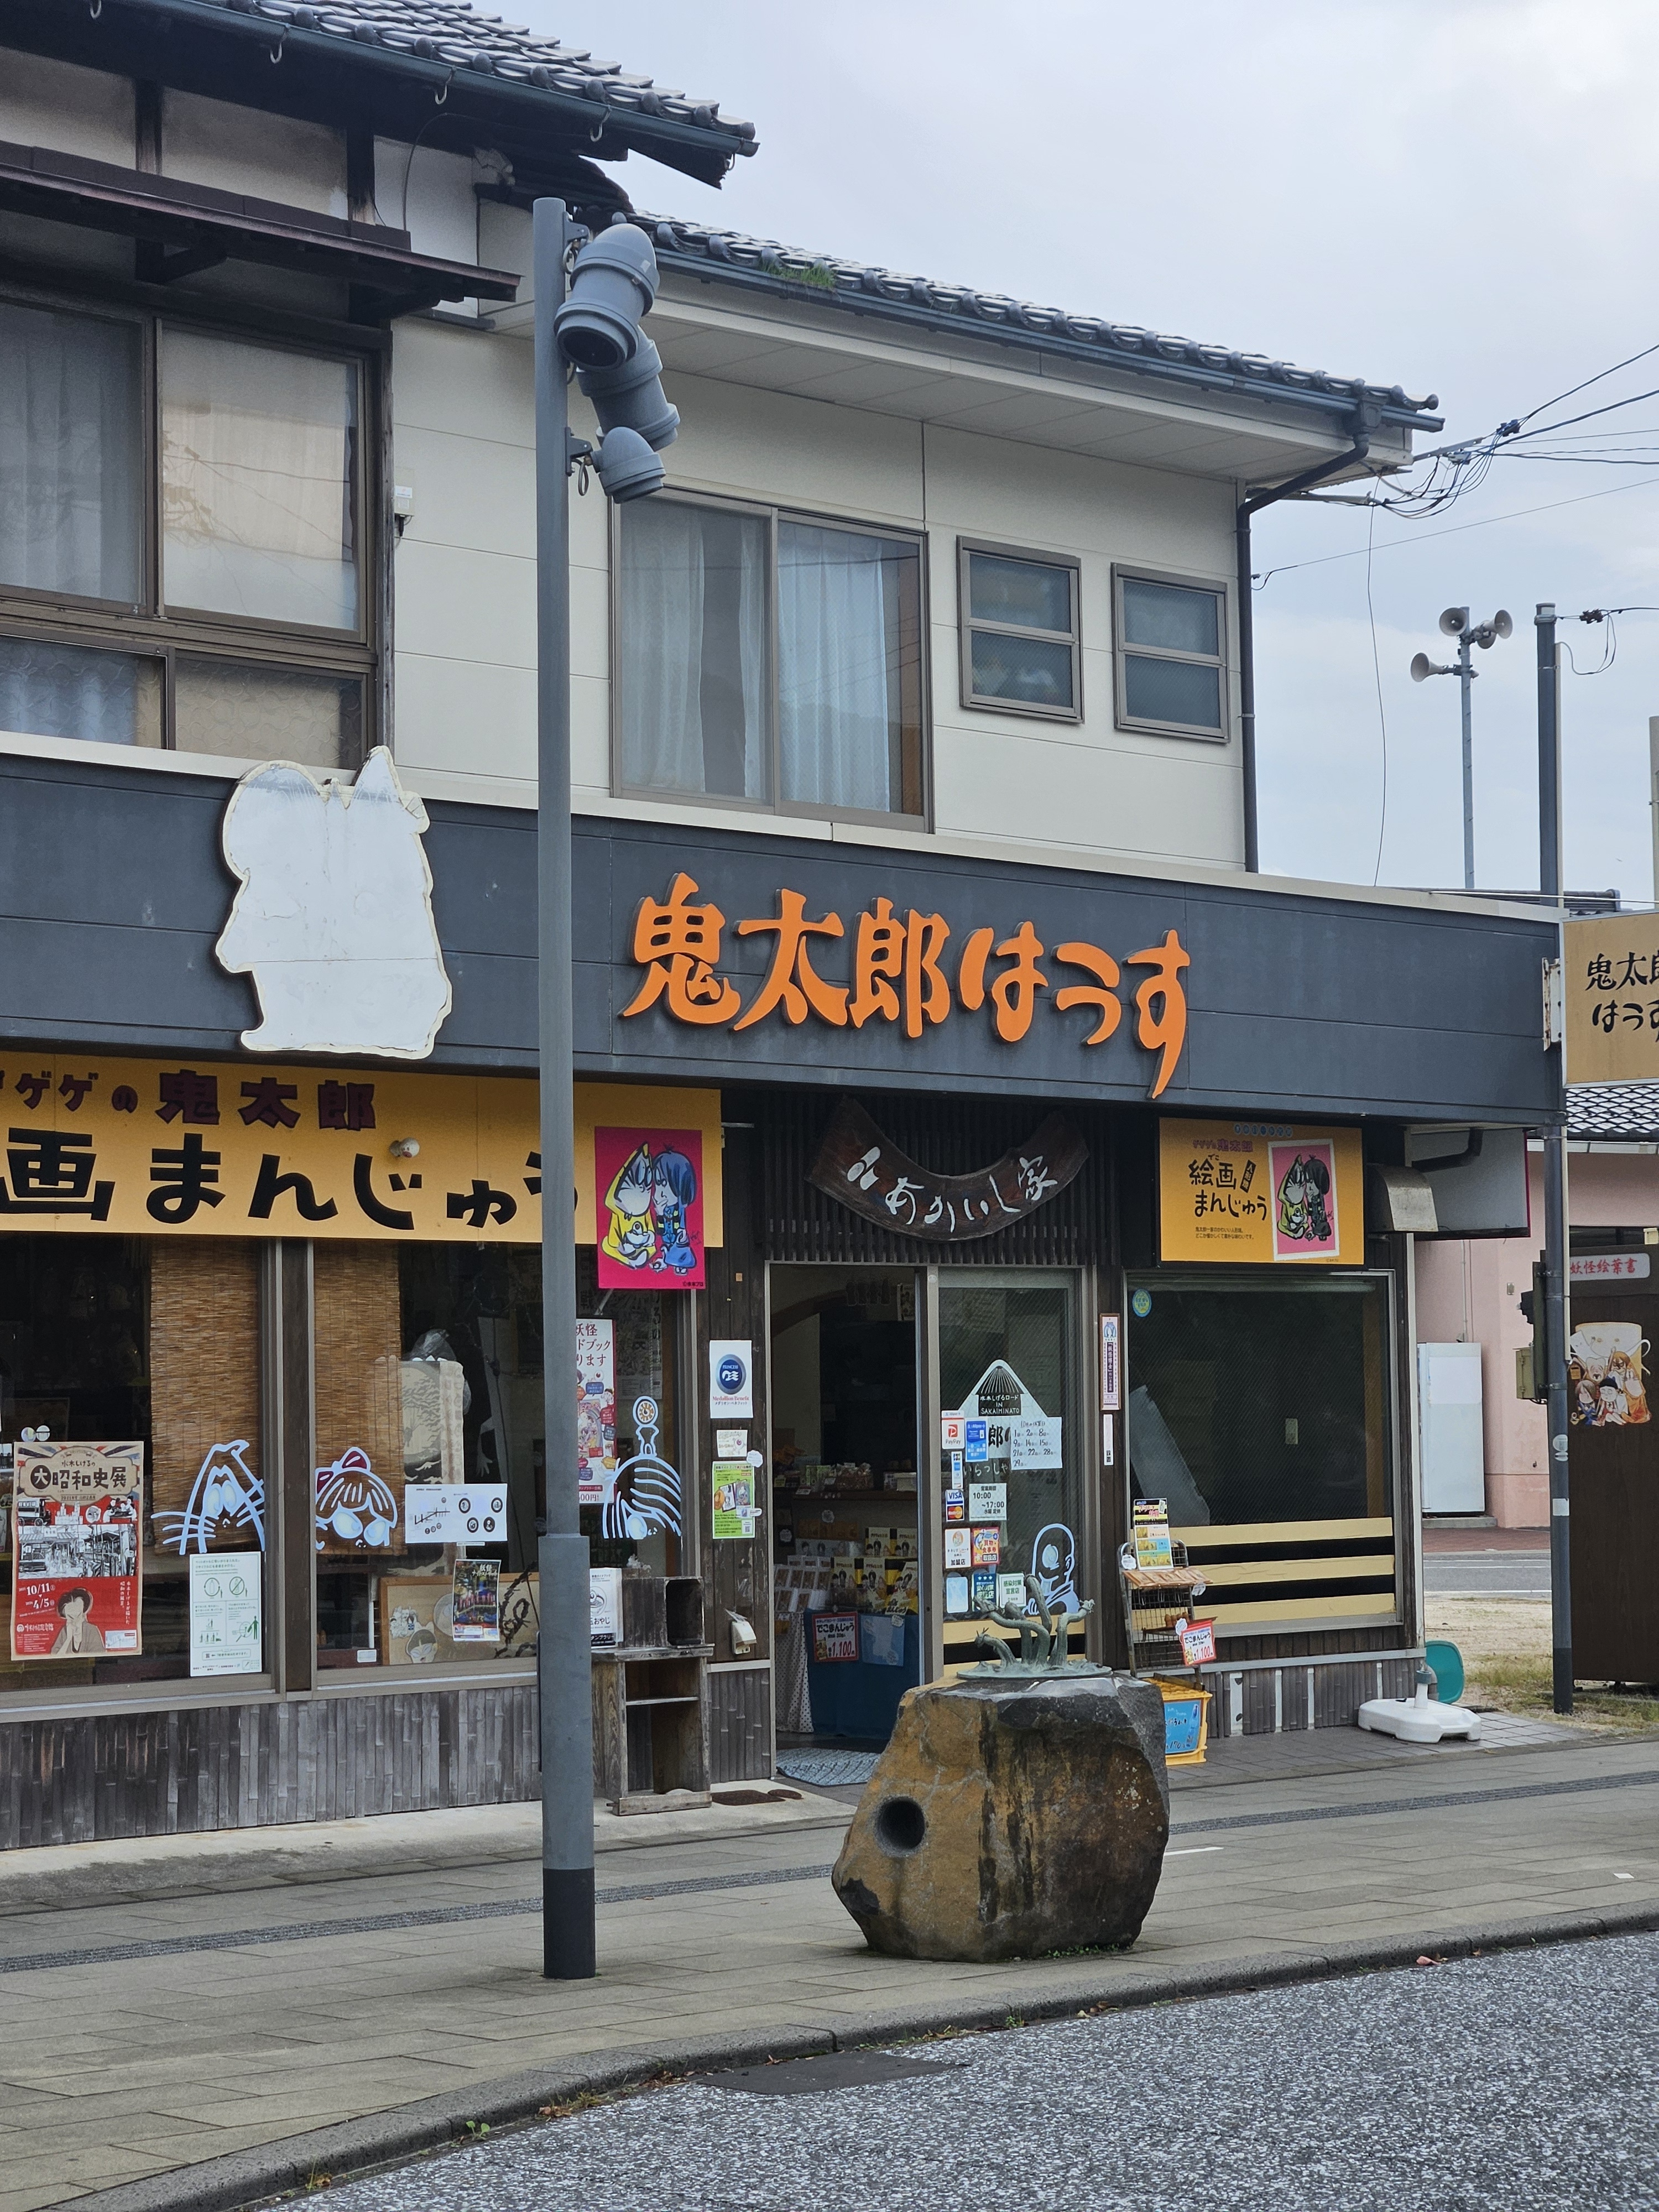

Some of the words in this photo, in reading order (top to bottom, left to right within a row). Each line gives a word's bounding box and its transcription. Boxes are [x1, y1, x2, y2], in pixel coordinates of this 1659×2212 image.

[619, 873, 1190, 1099] 鬼太郎はうす
[0, 1069, 377, 1131] ゲゲの鬼太郎
[1188, 1159, 1237, 1190] 絵画
[1194, 1190, 1267, 1220] まんじゅう
[1570, 1257, 1637, 1275] 妖怪絵葉書
[61, 1459, 96, 1468] 水木しげるの
[32, 1465, 127, 1490] 大昭和史展
[26, 1582, 50, 1596] 10/11
[33, 1598, 50, 1609] 4/5
[816, 1622, 854, 1633] でこまんじゅう
